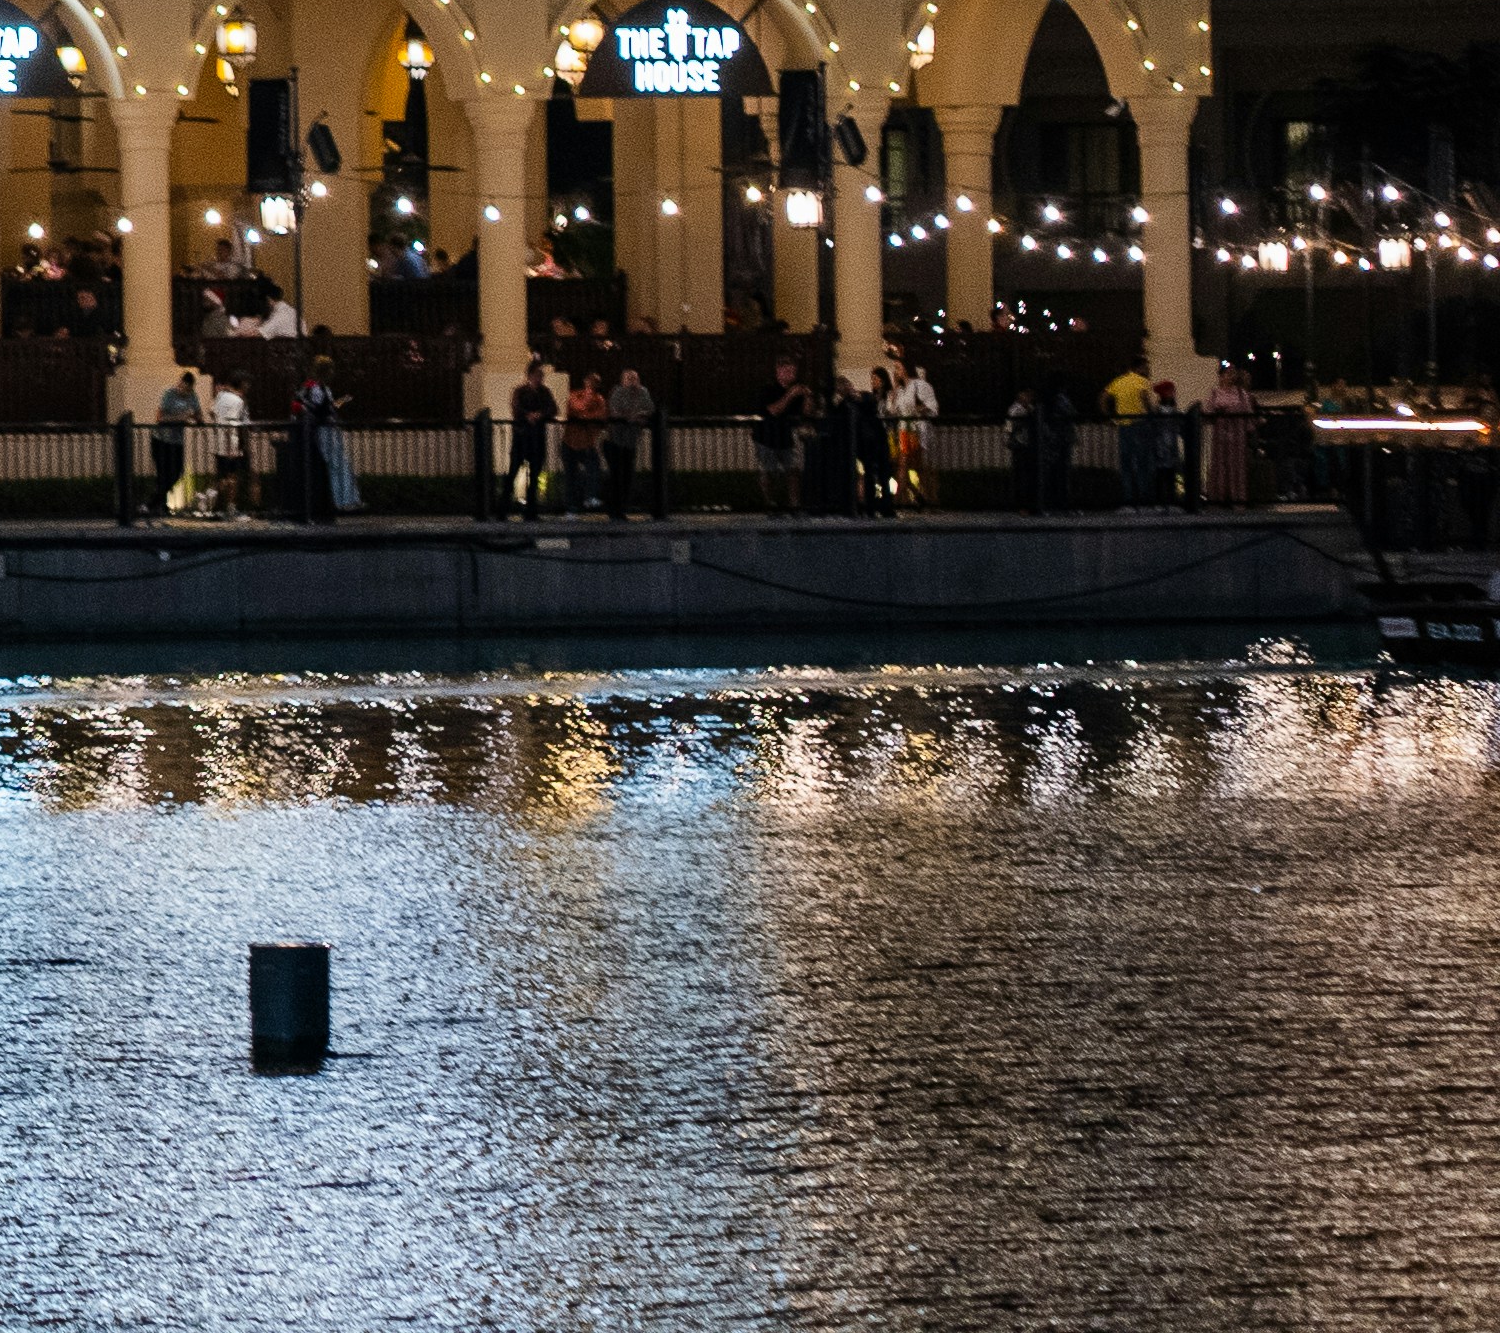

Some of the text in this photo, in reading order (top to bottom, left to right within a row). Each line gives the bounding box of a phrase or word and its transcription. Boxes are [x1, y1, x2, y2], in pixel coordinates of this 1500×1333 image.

[615, 26, 740, 60] THE TAP
[634, 60, 721, 93] HOUSE
